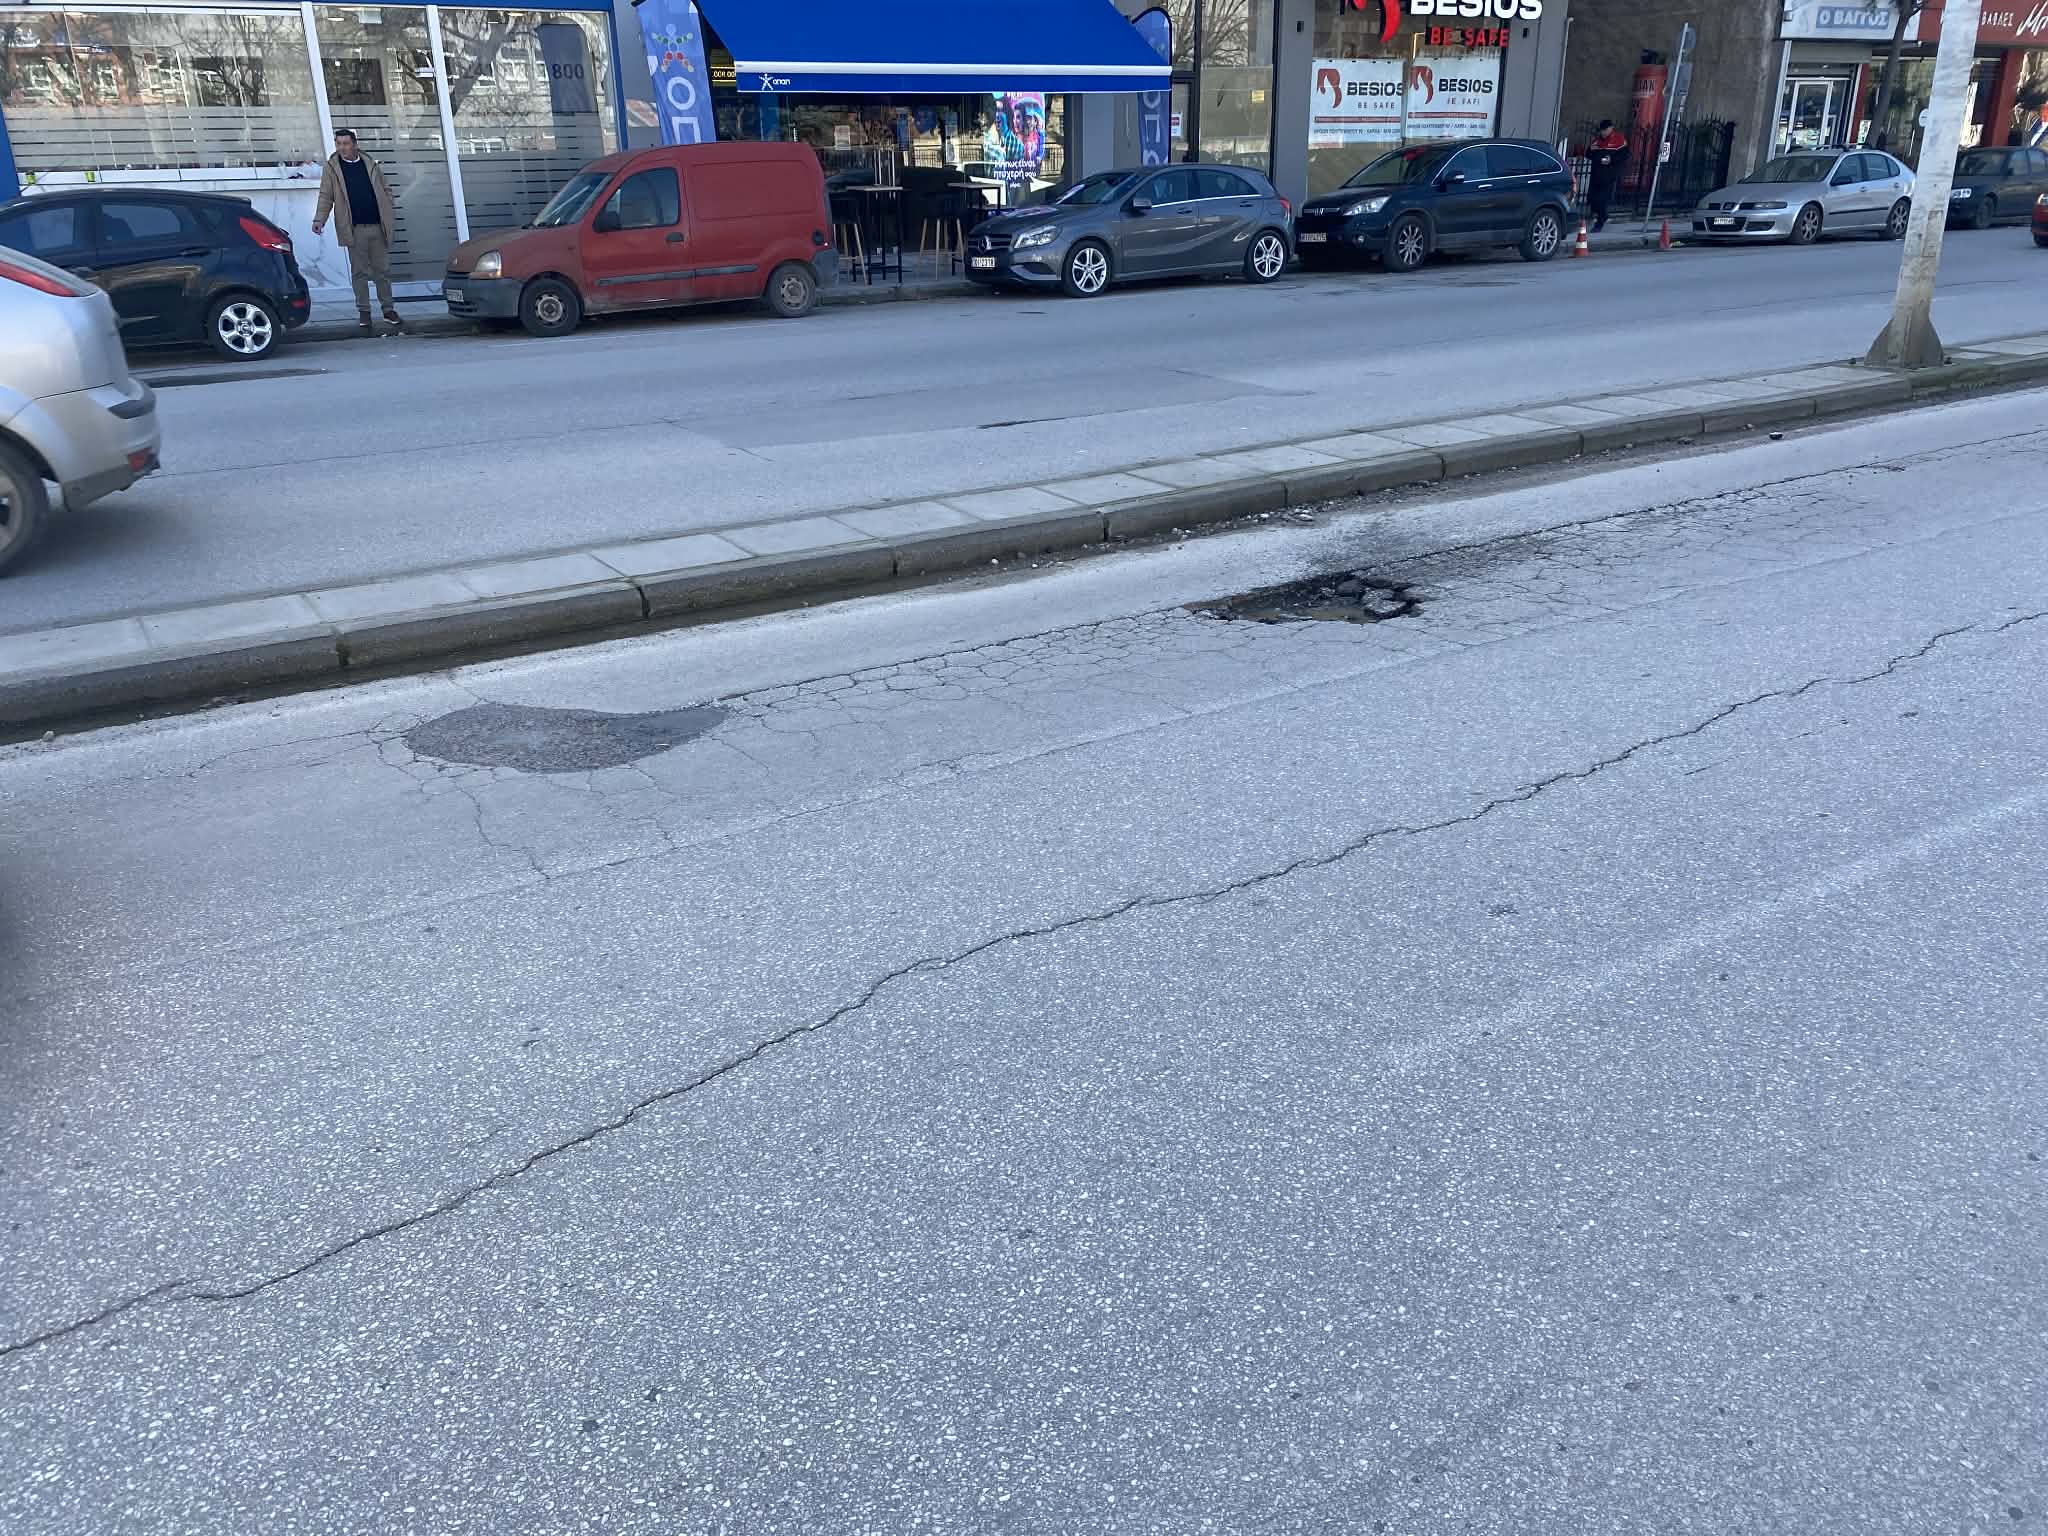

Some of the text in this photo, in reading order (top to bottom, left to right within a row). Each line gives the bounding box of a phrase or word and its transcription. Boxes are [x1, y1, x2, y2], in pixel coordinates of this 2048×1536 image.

[1410, 0, 1542, 19] BESIOS
[1431, 26, 1510, 47] BE SAFE
[552, 63, 584, 79] 800
[1346, 81, 1403, 97] BESIOS
[1438, 78, 1493, 94] BESIOS
